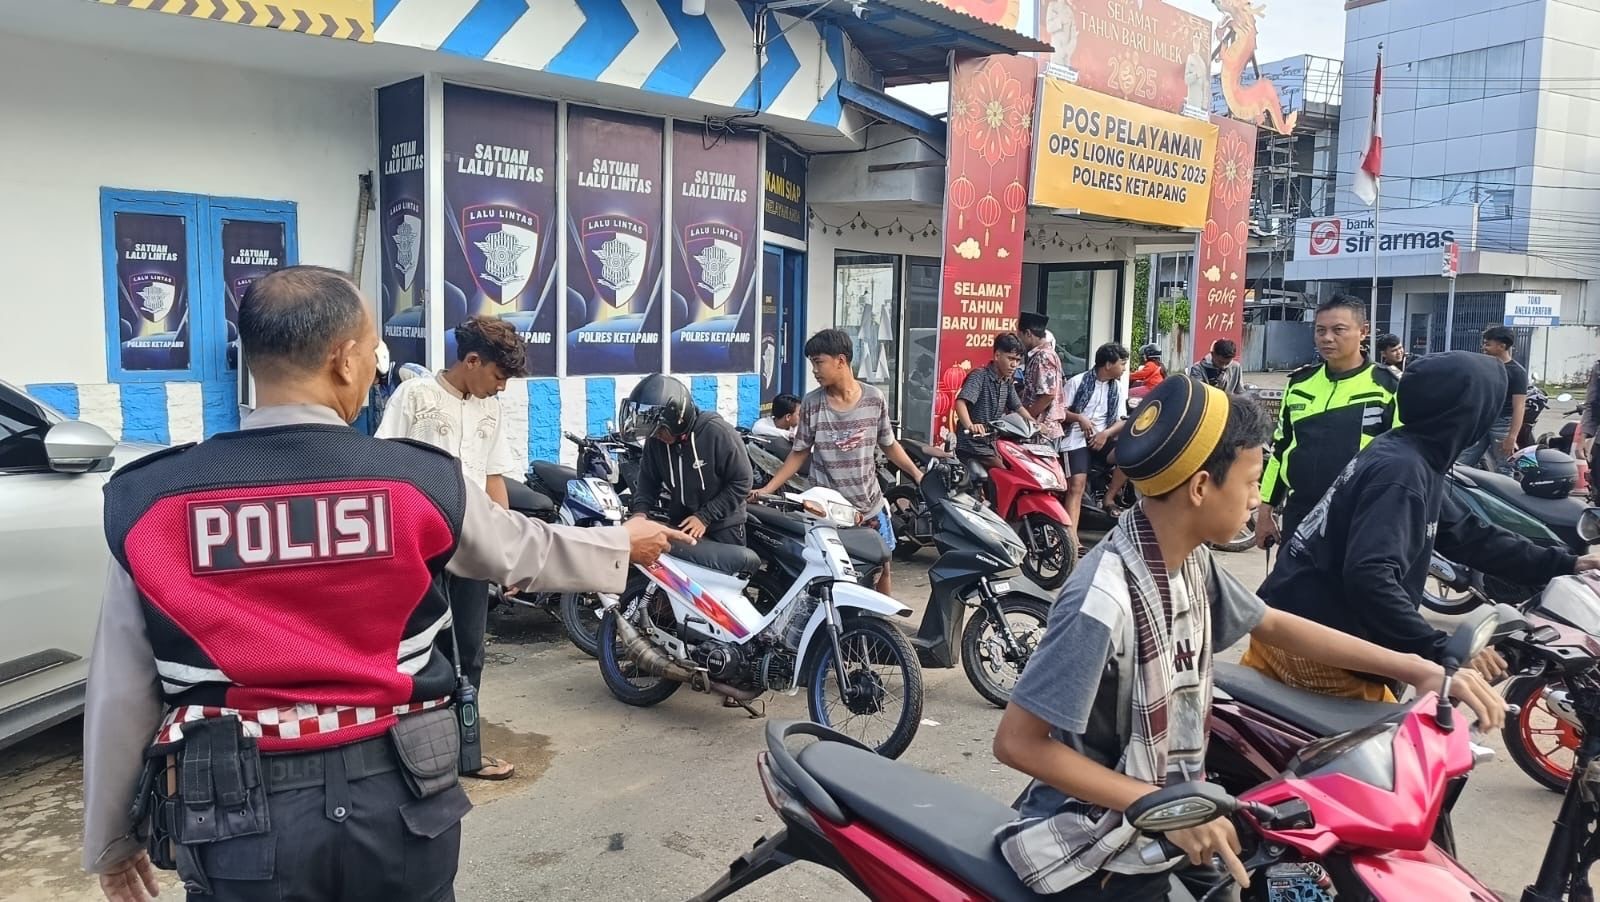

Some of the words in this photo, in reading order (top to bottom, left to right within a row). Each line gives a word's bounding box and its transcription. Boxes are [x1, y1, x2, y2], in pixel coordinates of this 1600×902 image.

[1107, 0, 1159, 34] SELAMAT
[1080, 11, 1119, 41] TAHUN
[1121, 27, 1151, 53] BARU
[1152, 39, 1183, 65] IMLEK
[1062, 103, 1101, 137] POS
[1104, 115, 1203, 161] PELAYANAN
[391, 140, 417, 159] SATUAN
[474, 143, 529, 165] SATUAN
[385, 159, 401, 175] LALU
[401, 154, 424, 172] LINTAS
[1049, 133, 1080, 159] OPS
[1082, 141, 1125, 168] LIONG
[1128, 151, 1178, 179] KAPUAS
[1180, 163, 1207, 185] 2025
[458, 157, 494, 177] LALU
[496, 162, 544, 183] LINTAS
[592, 158, 639, 178] SATUAN
[578, 171, 609, 189] LALU
[611, 175, 652, 194] LINTAS
[694, 170, 736, 188] SATUAN
[765, 170, 785, 198] KAMI
[785, 180, 801, 204] SIAP
[1072, 165, 1123, 192] POLRES
[1125, 176, 1187, 204] KETAPANG
[682, 182, 710, 199] LALU
[710, 186, 748, 203] LINTAS
[389, 202, 402, 216] LALU
[402, 201, 419, 213] LINTAS
[470, 209, 495, 220] LALU
[499, 209, 533, 226] LINTAS
[1346, 218, 1374, 230] bank
[588, 219, 610, 230] LALU
[613, 219, 643, 234] LINTAS
[690, 227, 710, 237] LALU
[712, 227, 738, 241] LINTAS
[125, 251, 147, 260] LALU
[148, 252, 178, 261] LINTAS
[135, 243, 168, 253] SATUAN
[239, 248, 270, 258] SATUAN
[231, 256, 250, 265] LALU
[251, 257, 278, 266] LINTAS
[150, 275, 172, 283] LINTAS
[954, 281, 1012, 298] SELAMAT
[1207, 287, 1237, 308] GONG
[960, 299, 1004, 315] TAHUN
[942, 316, 978, 330] BARU
[981, 317, 1019, 331] IMLEK
[1204, 313, 1219, 330] XI
[1219, 312, 1235, 332] FA
[578, 332, 612, 343] POLRES
[613, 332, 658, 344] KETAPANG
[680, 331, 710, 342] POLRES
[710, 332, 750, 343] KETAPANG
[965, 333, 995, 347] 2025
[192, 494, 390, 567] POLISI
[975, 553, 999, 567] HONDA
